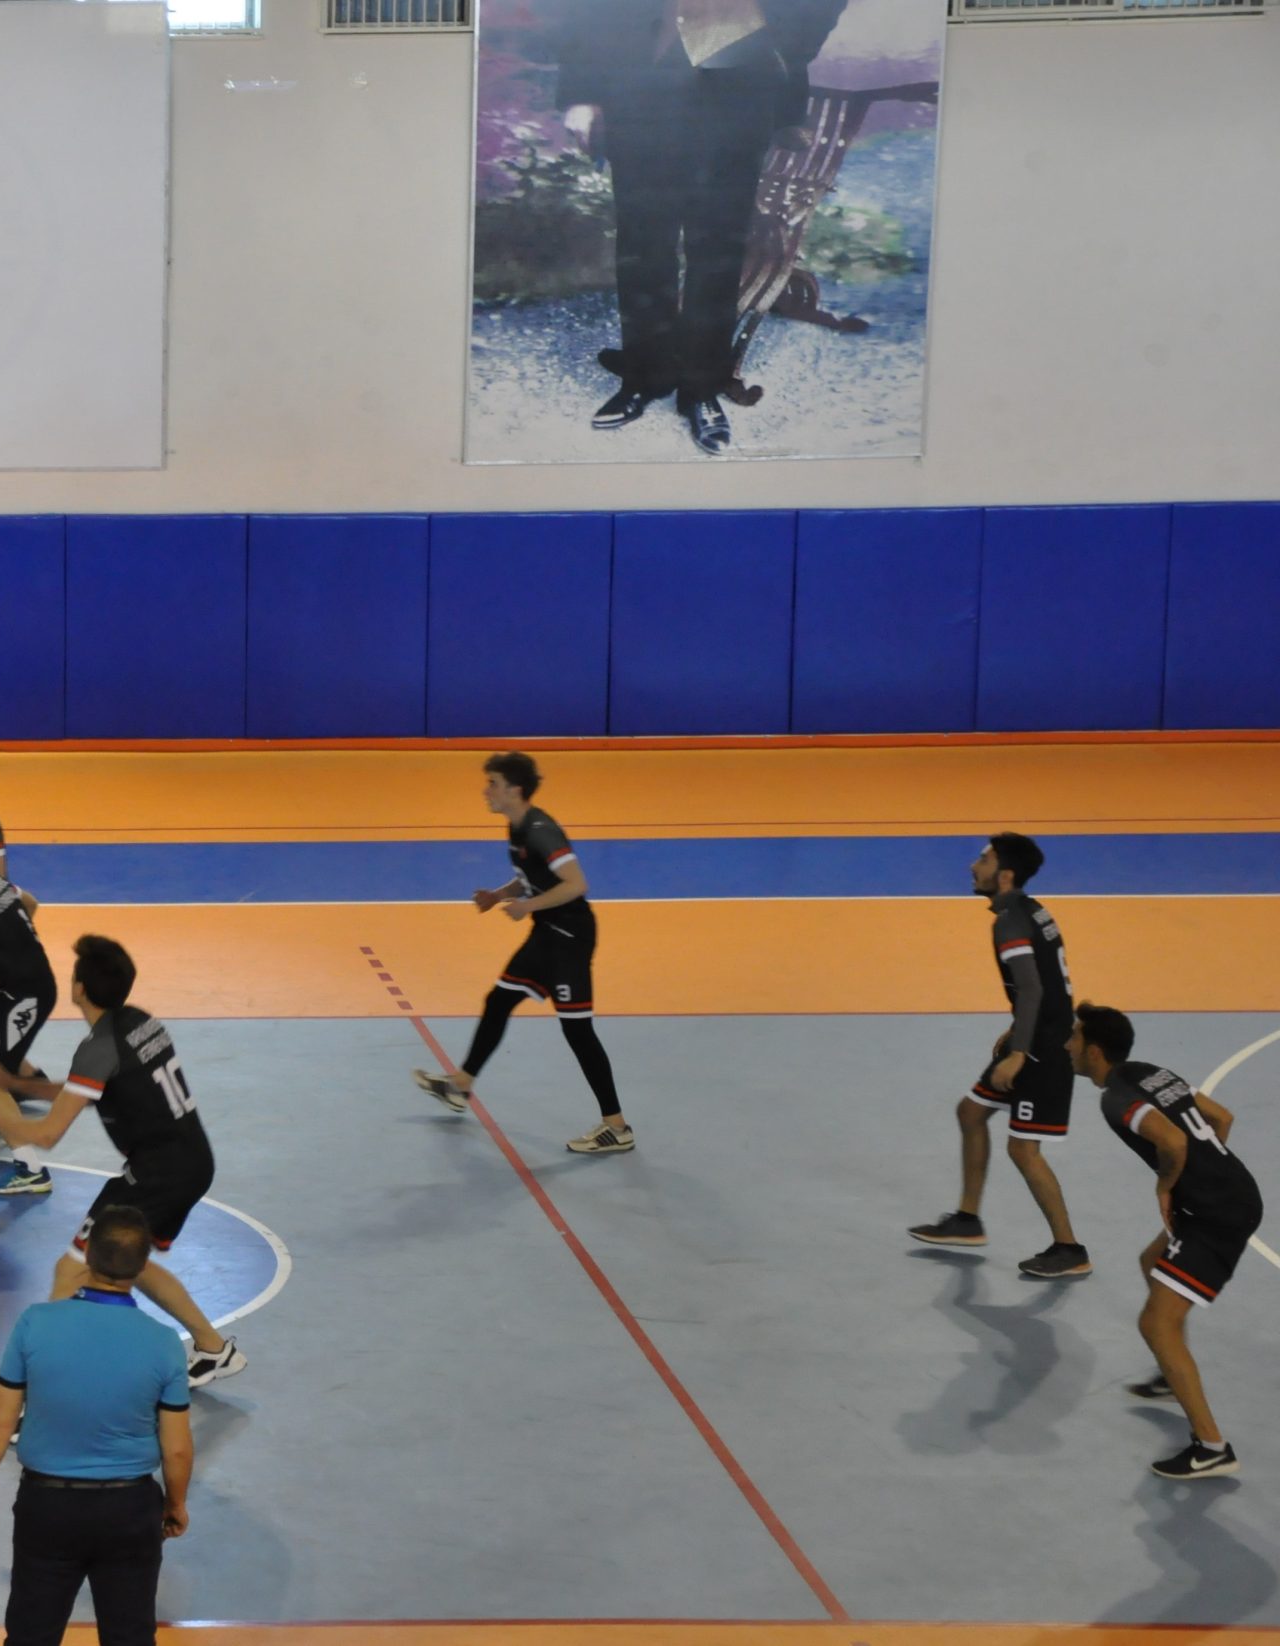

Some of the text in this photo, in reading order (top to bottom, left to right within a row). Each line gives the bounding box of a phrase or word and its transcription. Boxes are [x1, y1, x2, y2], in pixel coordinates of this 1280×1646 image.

[556, 984, 571, 1002] 3
[152, 1058, 197, 1120] 10
[1018, 1100, 1034, 1121] 6
[1180, 1106, 1228, 1156] 4
